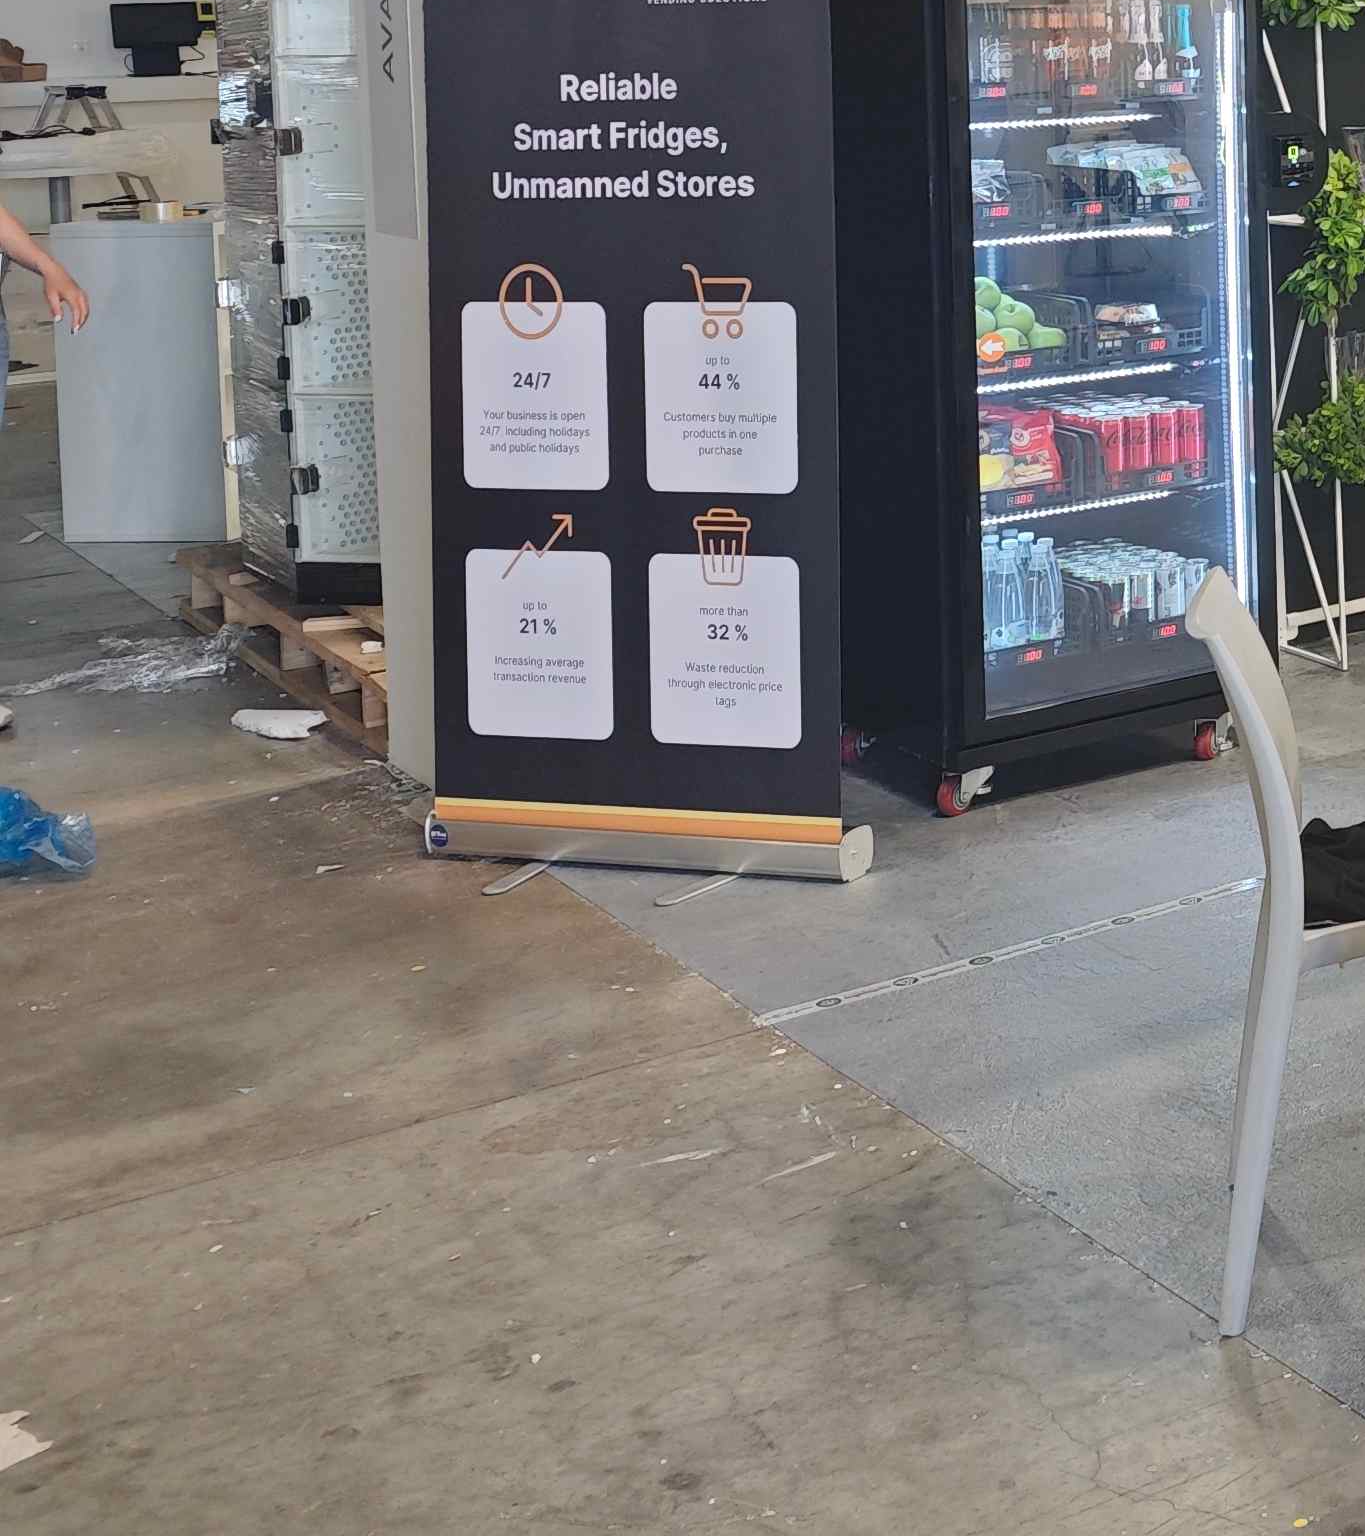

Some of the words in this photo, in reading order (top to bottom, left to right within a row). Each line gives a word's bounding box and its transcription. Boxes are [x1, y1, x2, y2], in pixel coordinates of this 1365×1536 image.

[559, 71, 678, 103] Reliable
[512, 121, 602, 151] Smart
[608, 120, 728, 156] Fridges,
[491, 169, 650, 200] Unmanned
[655, 169, 755, 198] Stores
[705, 356, 718, 368] up
[719, 355, 730, 366] to
[512, 371, 552, 391] 24/7
[698, 373, 722, 390] 44
[726, 373, 741, 391] %
[483, 409, 504, 421] Your
[506, 410, 548, 421] business
[549, 410, 558, 421] is
[560, 411, 586, 422] open
[662, 411, 717, 423] Customers
[718, 412, 737, 425] buy
[738, 413, 778, 425] multiple
[549, 427, 591, 440] holidays
[682, 428, 727, 440] products
[728, 428, 737, 439] in
[739, 431, 759, 440] one
[489, 443, 507, 453] and
[508, 443, 537, 454] public
[538, 443, 581, 455] holidays
[698, 446, 744, 457] purchase
[522, 602, 535, 612] up
[537, 601, 548, 610] to
[699, 606, 725, 616] more
[727, 605, 749, 617] than
[519, 617, 537, 634] 21
[543, 617, 557, 635] %
[706, 623, 730, 641] 32
[734, 623, 749, 642] %
[494, 655, 543, 669] Increasing
[544, 658, 585, 670] average
[684, 661, 717, 673] Waste
[718, 663, 765, 675] reduction
[493, 671, 546, 683] transaction
[547, 674, 587, 685] revenue
[667, 677, 706, 692] through
[708, 679, 757, 691] electronic
[758, 680, 784, 693] price
[715, 696, 737, 709] tags
